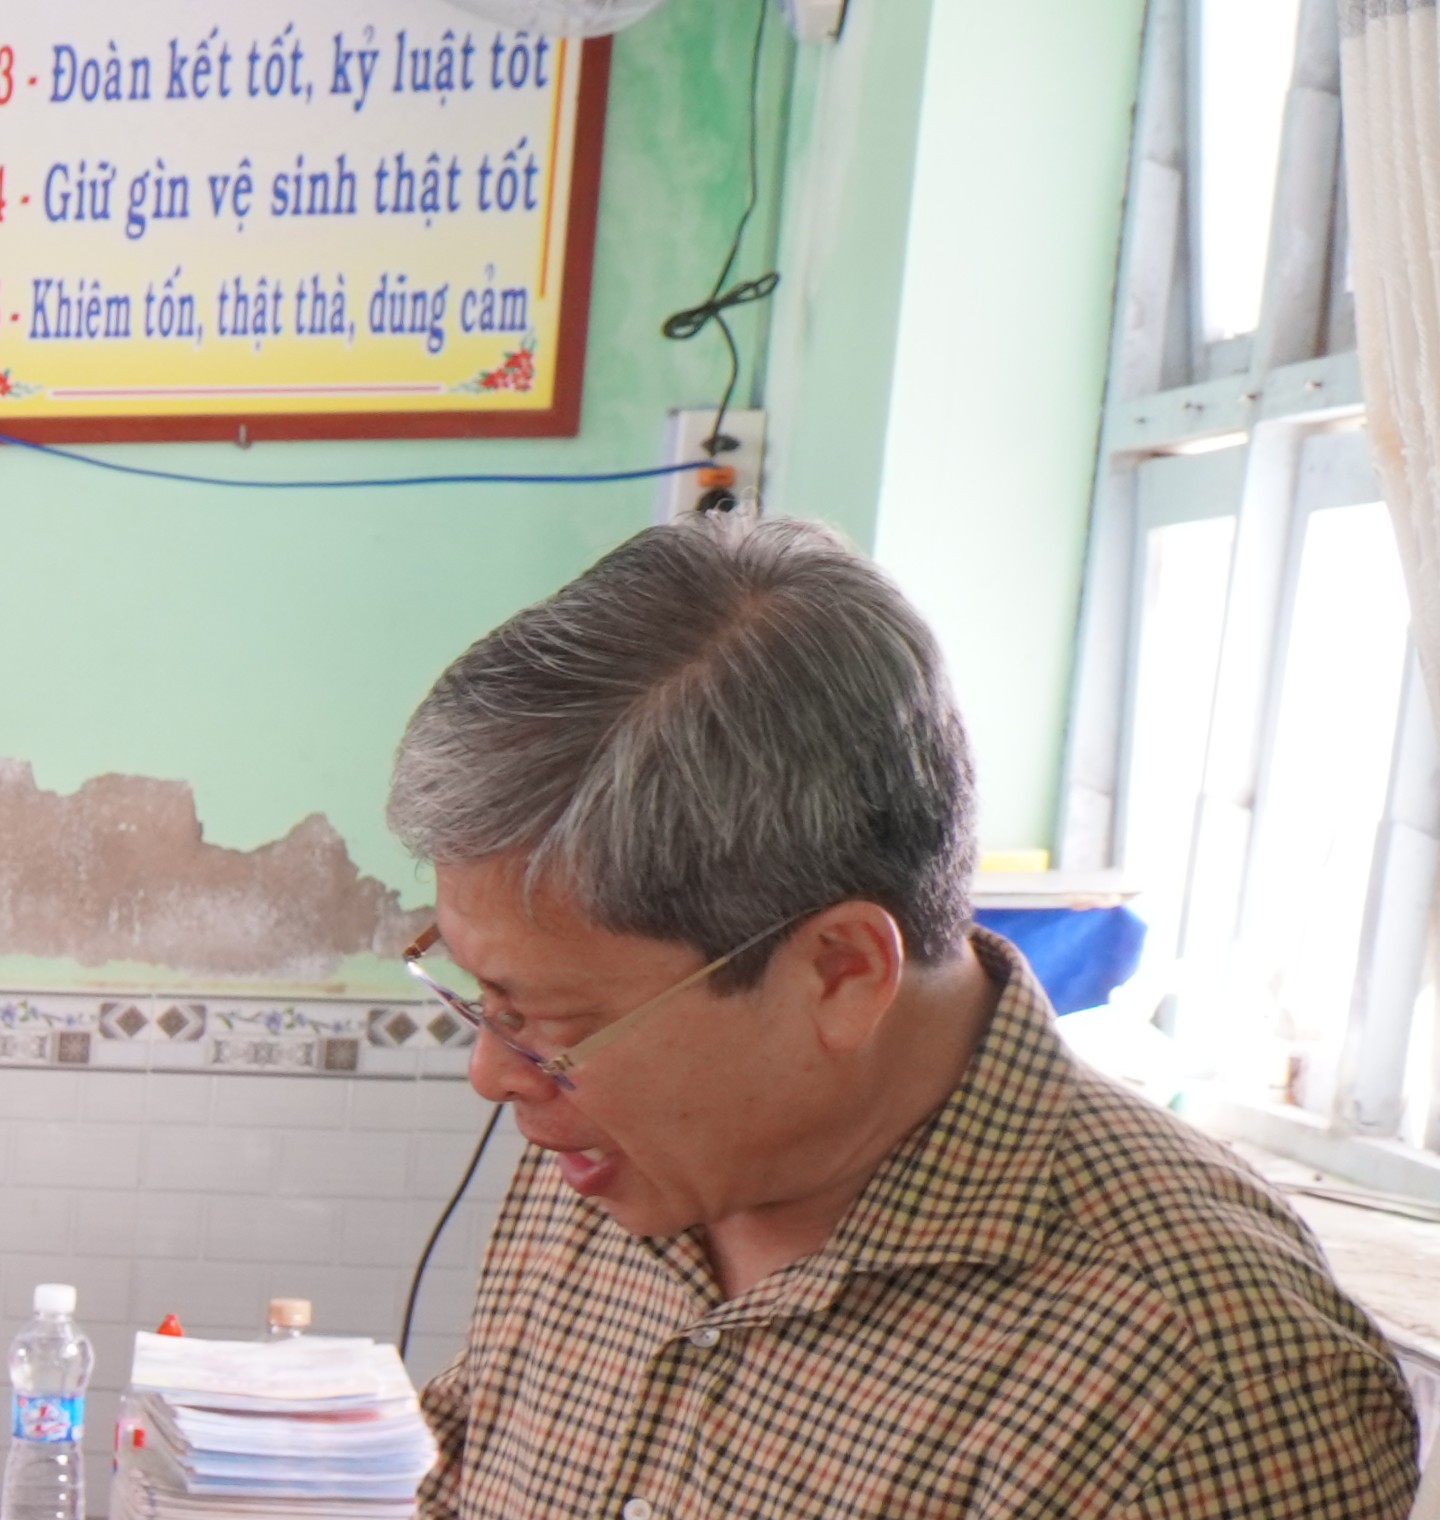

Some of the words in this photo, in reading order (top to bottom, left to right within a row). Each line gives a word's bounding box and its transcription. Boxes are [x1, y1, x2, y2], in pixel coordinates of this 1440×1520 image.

[49, 39, 152, 103] Đoàn
[165, 24, 232, 99] kết
[247, 21, 314, 105] tốt,
[329, 24, 380, 113] kỷ
[392, 28, 476, 107] luật
[43, 158, 118, 223] Giữ
[124, 157, 191, 240] gìn
[206, 156, 255, 233] vệ
[270, 152, 358, 217] sinh
[374, 151, 463, 229] thật
[477, 134, 540, 213] tốt
[28, 278, 133, 339] Khiêm
[144, 263, 206, 347] tốn,
[217, 274, 284, 351] thật
[295, 272, 357, 345] thà,
[368, 272, 452, 354] dũng
[460, 261, 530, 334] cảm
